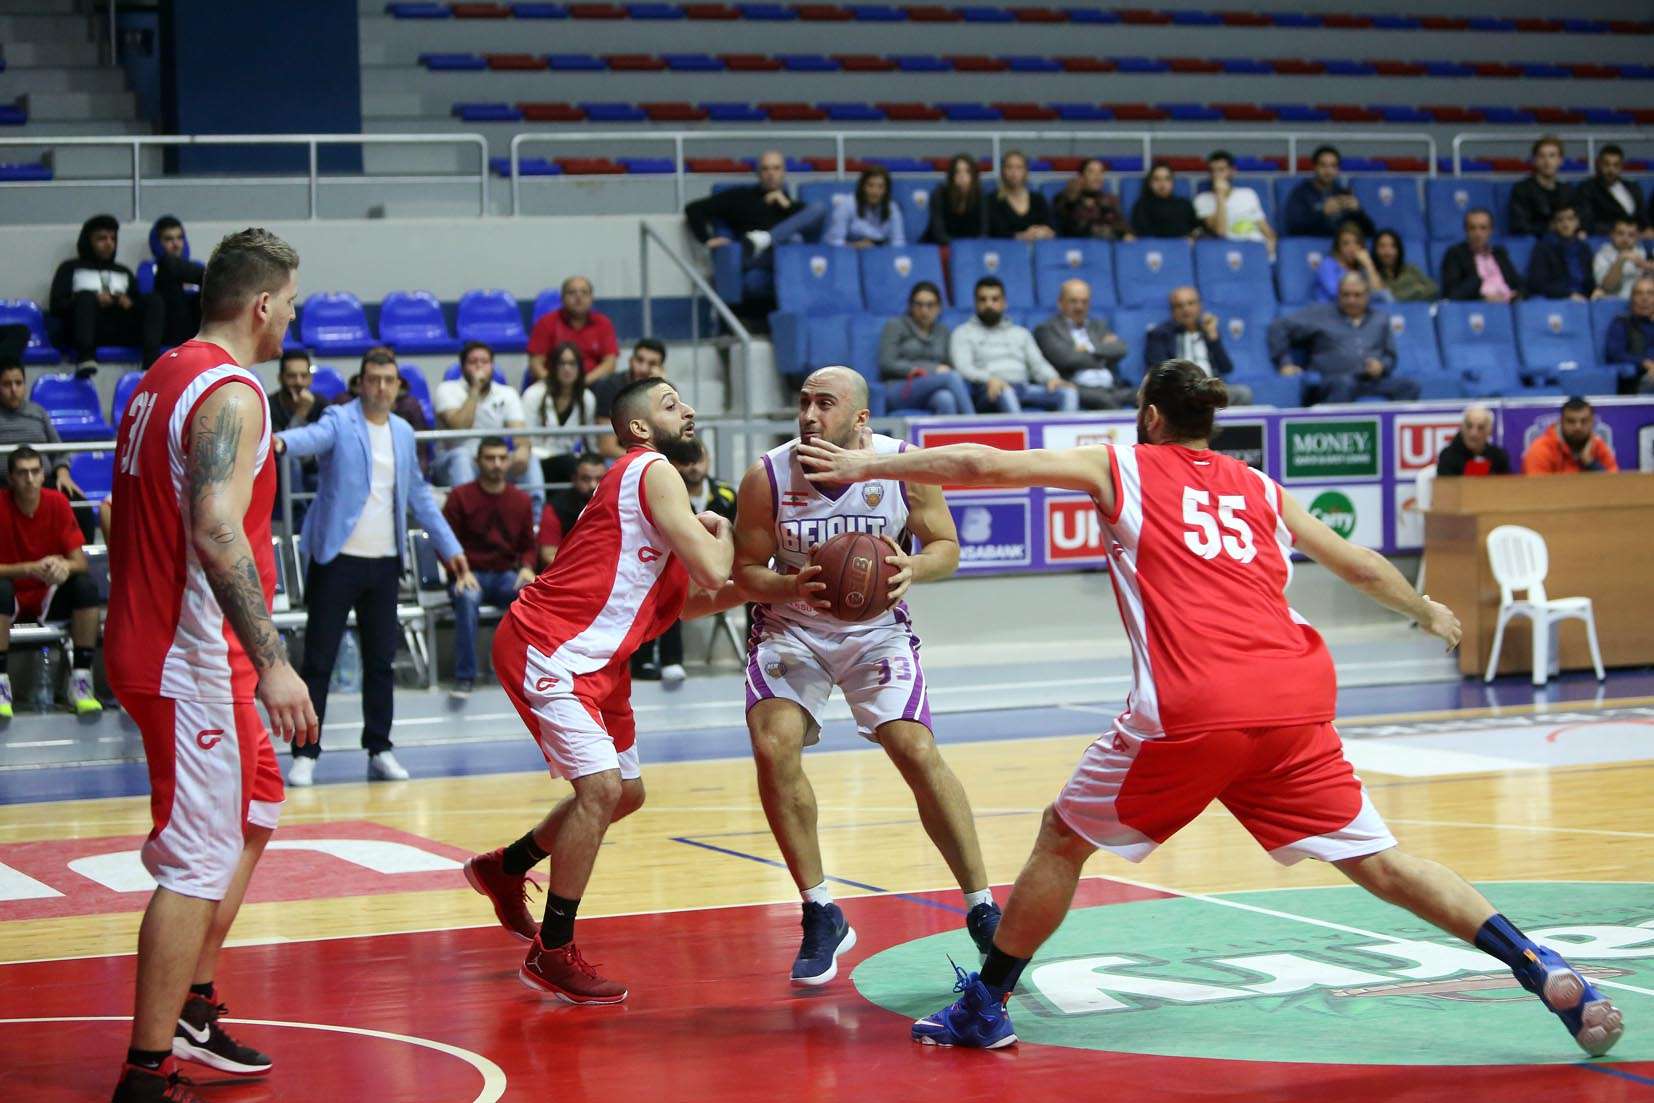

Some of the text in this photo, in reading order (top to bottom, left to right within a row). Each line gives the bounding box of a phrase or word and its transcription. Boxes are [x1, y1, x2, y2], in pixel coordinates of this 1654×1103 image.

[122, 391, 158, 476] 31
[1293, 431, 1370, 453] MONEY
[1183, 486, 1257, 563] 55
